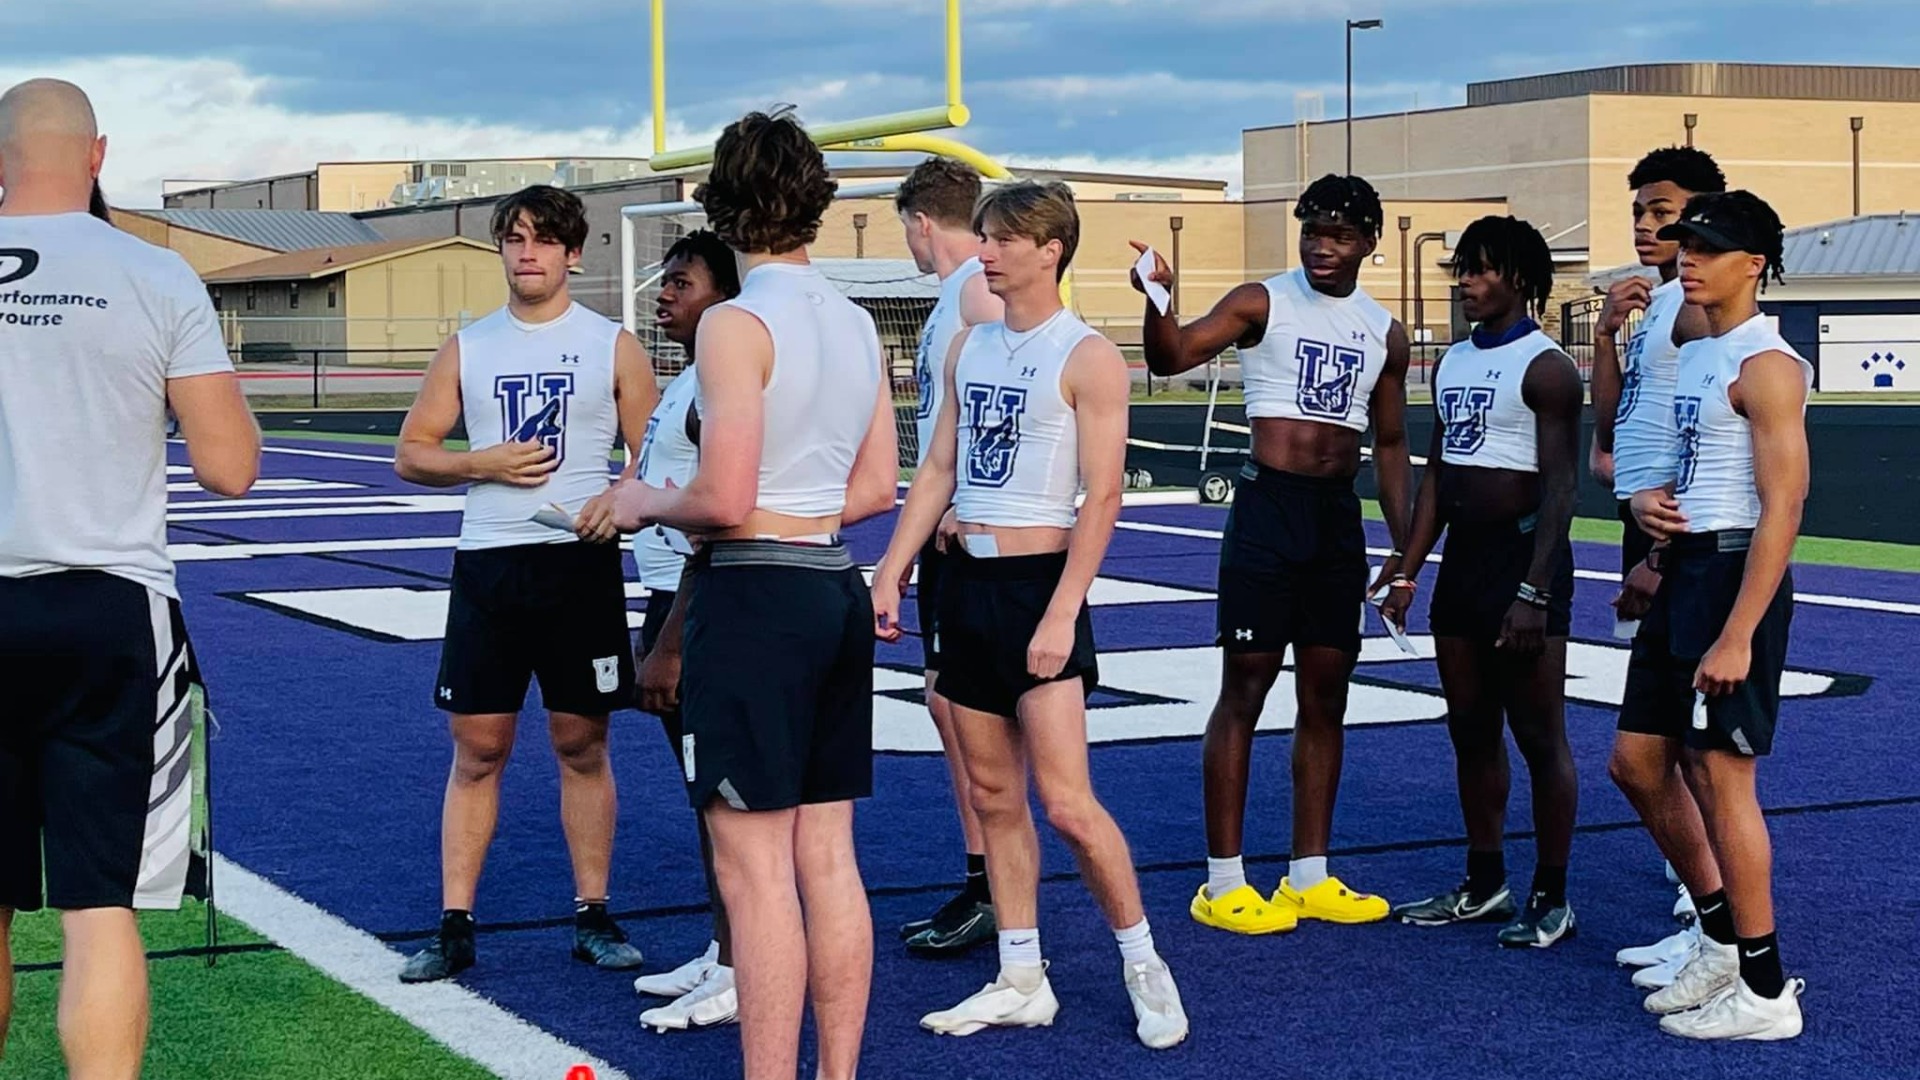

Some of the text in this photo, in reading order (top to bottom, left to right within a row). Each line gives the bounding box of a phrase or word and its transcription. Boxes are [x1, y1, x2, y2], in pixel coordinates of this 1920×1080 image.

[0, 290, 107, 309] rformance
[1295, 338, 1364, 420] U
[494, 372, 575, 472] U
[964, 382, 1027, 488] U
[1440, 387, 1496, 455] U
